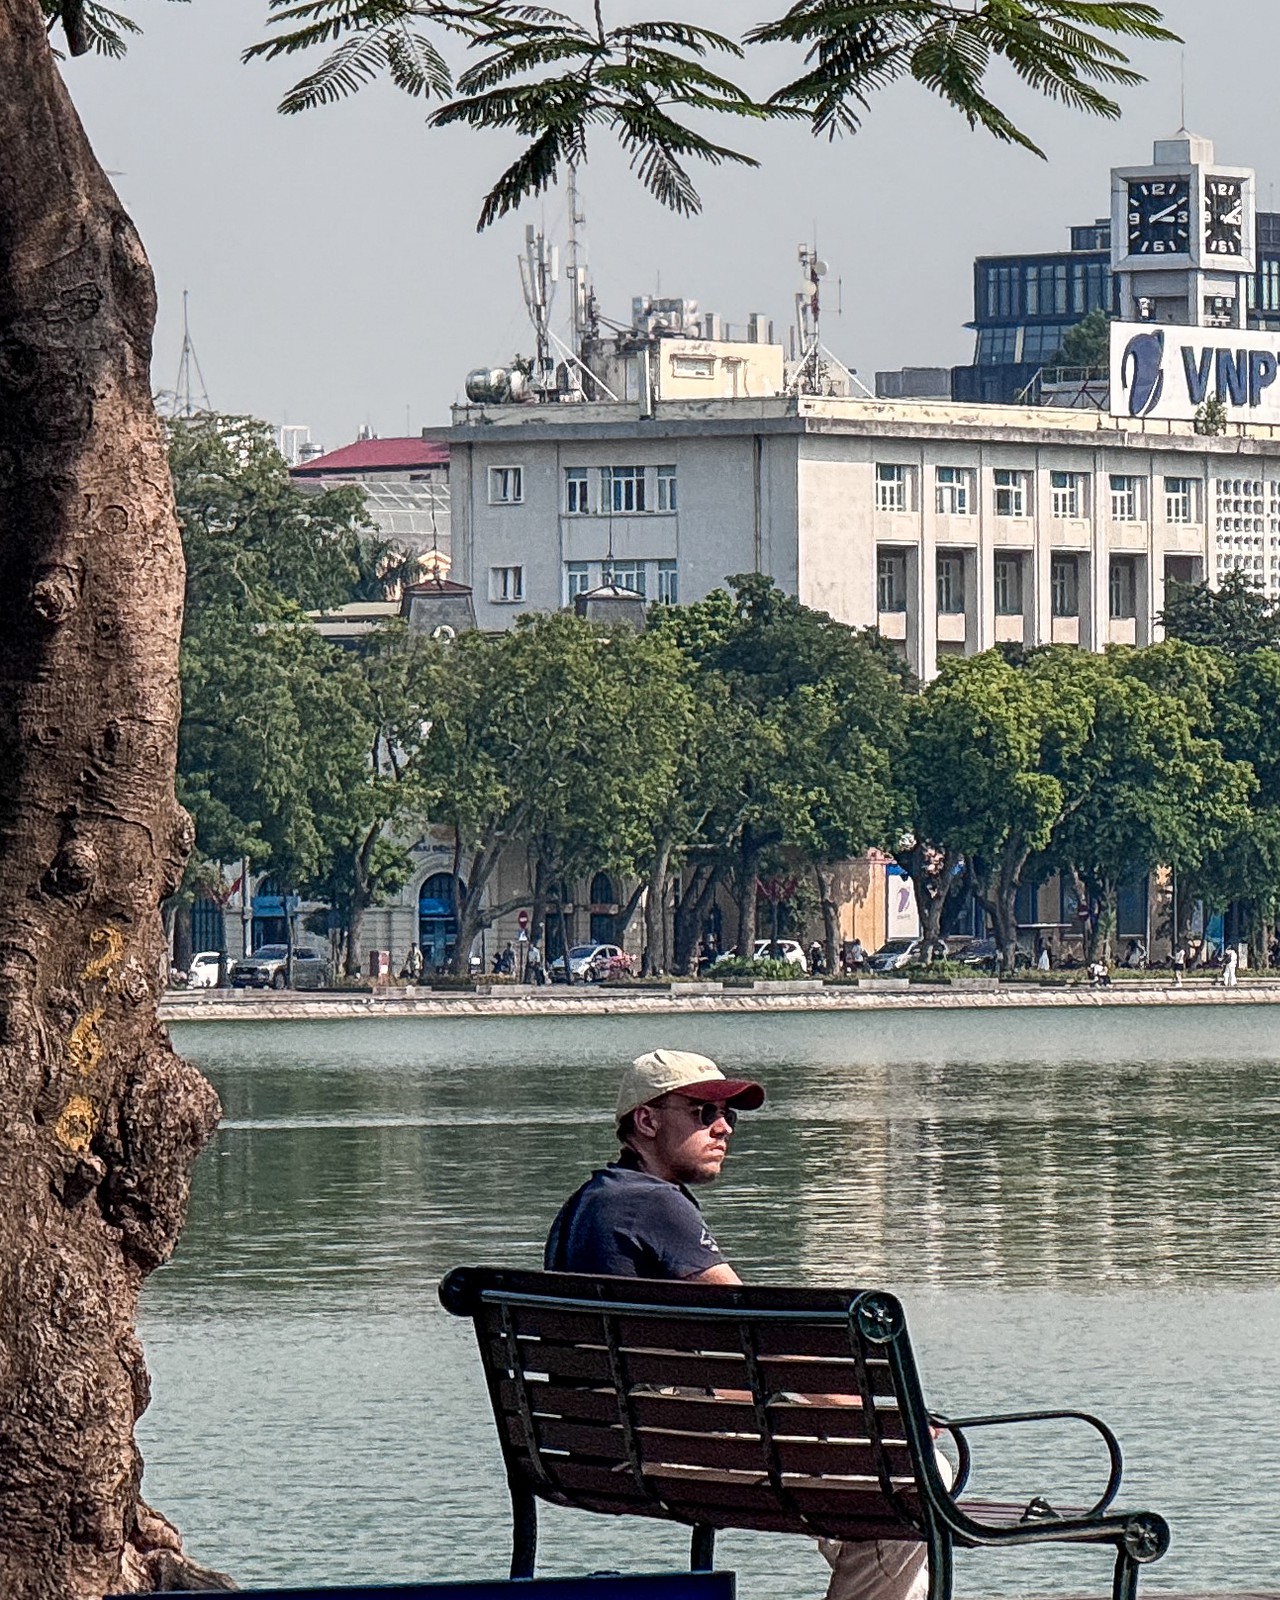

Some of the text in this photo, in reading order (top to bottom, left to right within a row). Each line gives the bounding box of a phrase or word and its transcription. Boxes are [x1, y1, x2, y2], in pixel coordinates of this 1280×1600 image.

[1152, 183, 1165, 195] 12
[1218, 183, 1227, 195] 12
[1129, 212, 1140, 225] 9
[1177, 211, 1188, 224] 3
[1153, 241, 1165, 252] 6
[1218, 240, 1227, 252] 6
